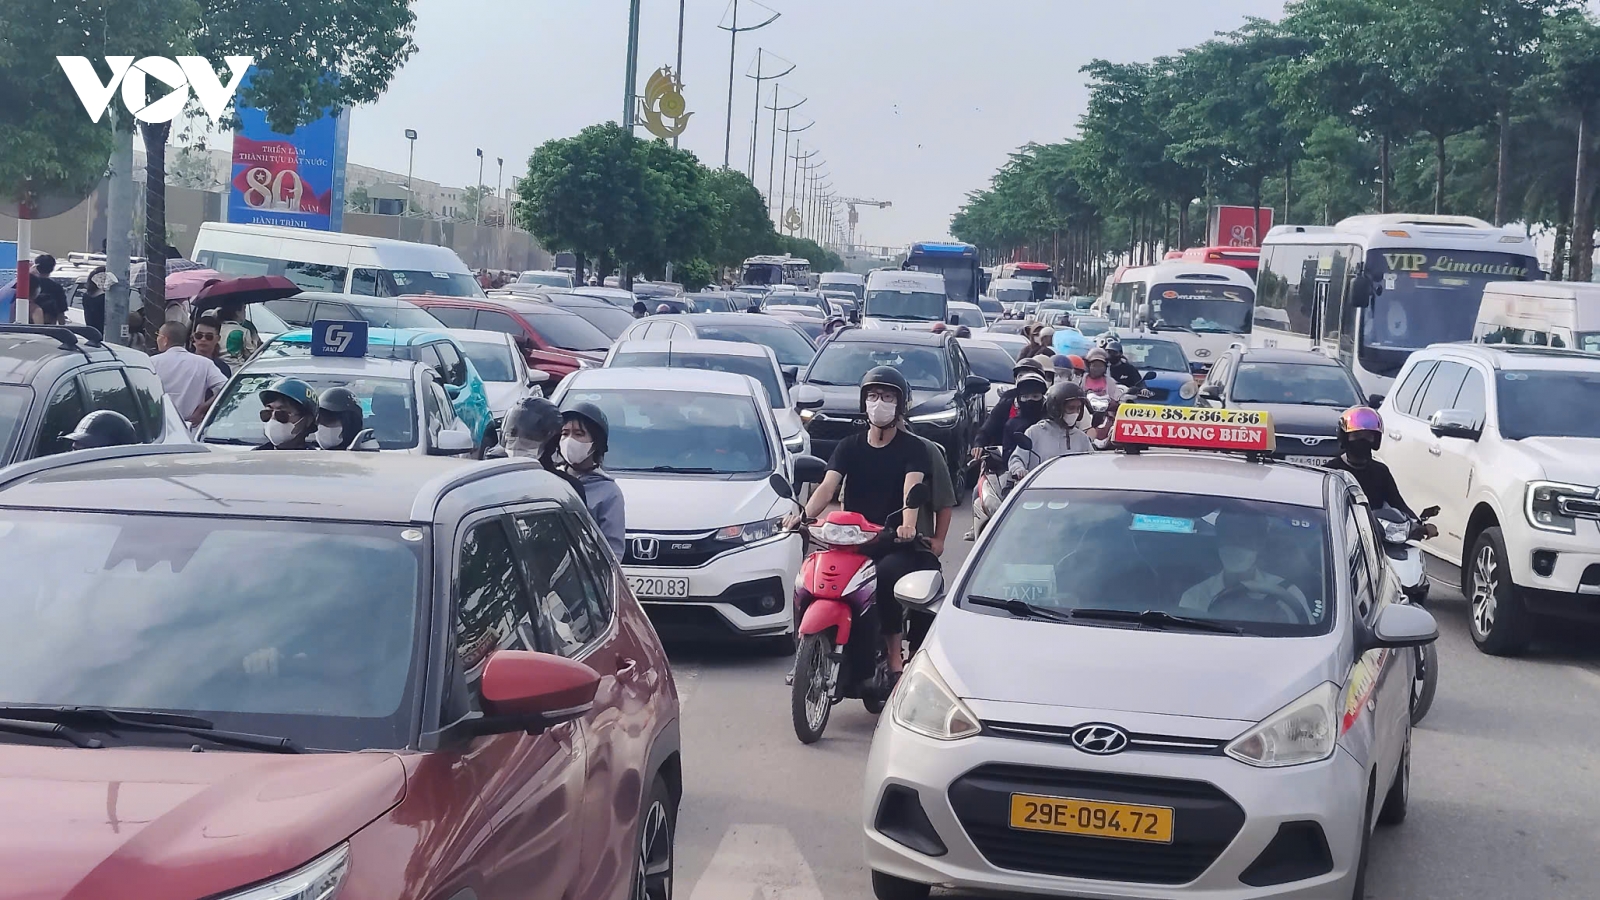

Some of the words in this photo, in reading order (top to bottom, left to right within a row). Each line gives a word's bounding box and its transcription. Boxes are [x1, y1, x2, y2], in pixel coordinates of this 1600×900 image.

[239, 152, 268, 161] THÀNH
[243, 167, 303, 211] 80
[252, 216, 278, 226] HÀNH
[280, 217, 307, 228] TRÌNH
[1382, 253, 1427, 271] VIP
[1429, 256, 1529, 277] Limousine
[325, 324, 353, 353] G7
[1124, 409, 1157, 419] (024)
[1161, 408, 1260, 425] 38.736.736
[1121, 423, 1162, 437] TAXI
[1167, 426, 1215, 442] LONG
[1219, 427, 1262, 443] BIÊN
[627, 578, 685, 596] -220.83
[1002, 586, 1036, 600] TAXI
[1024, 801, 1158, 835] 29E-094.72
